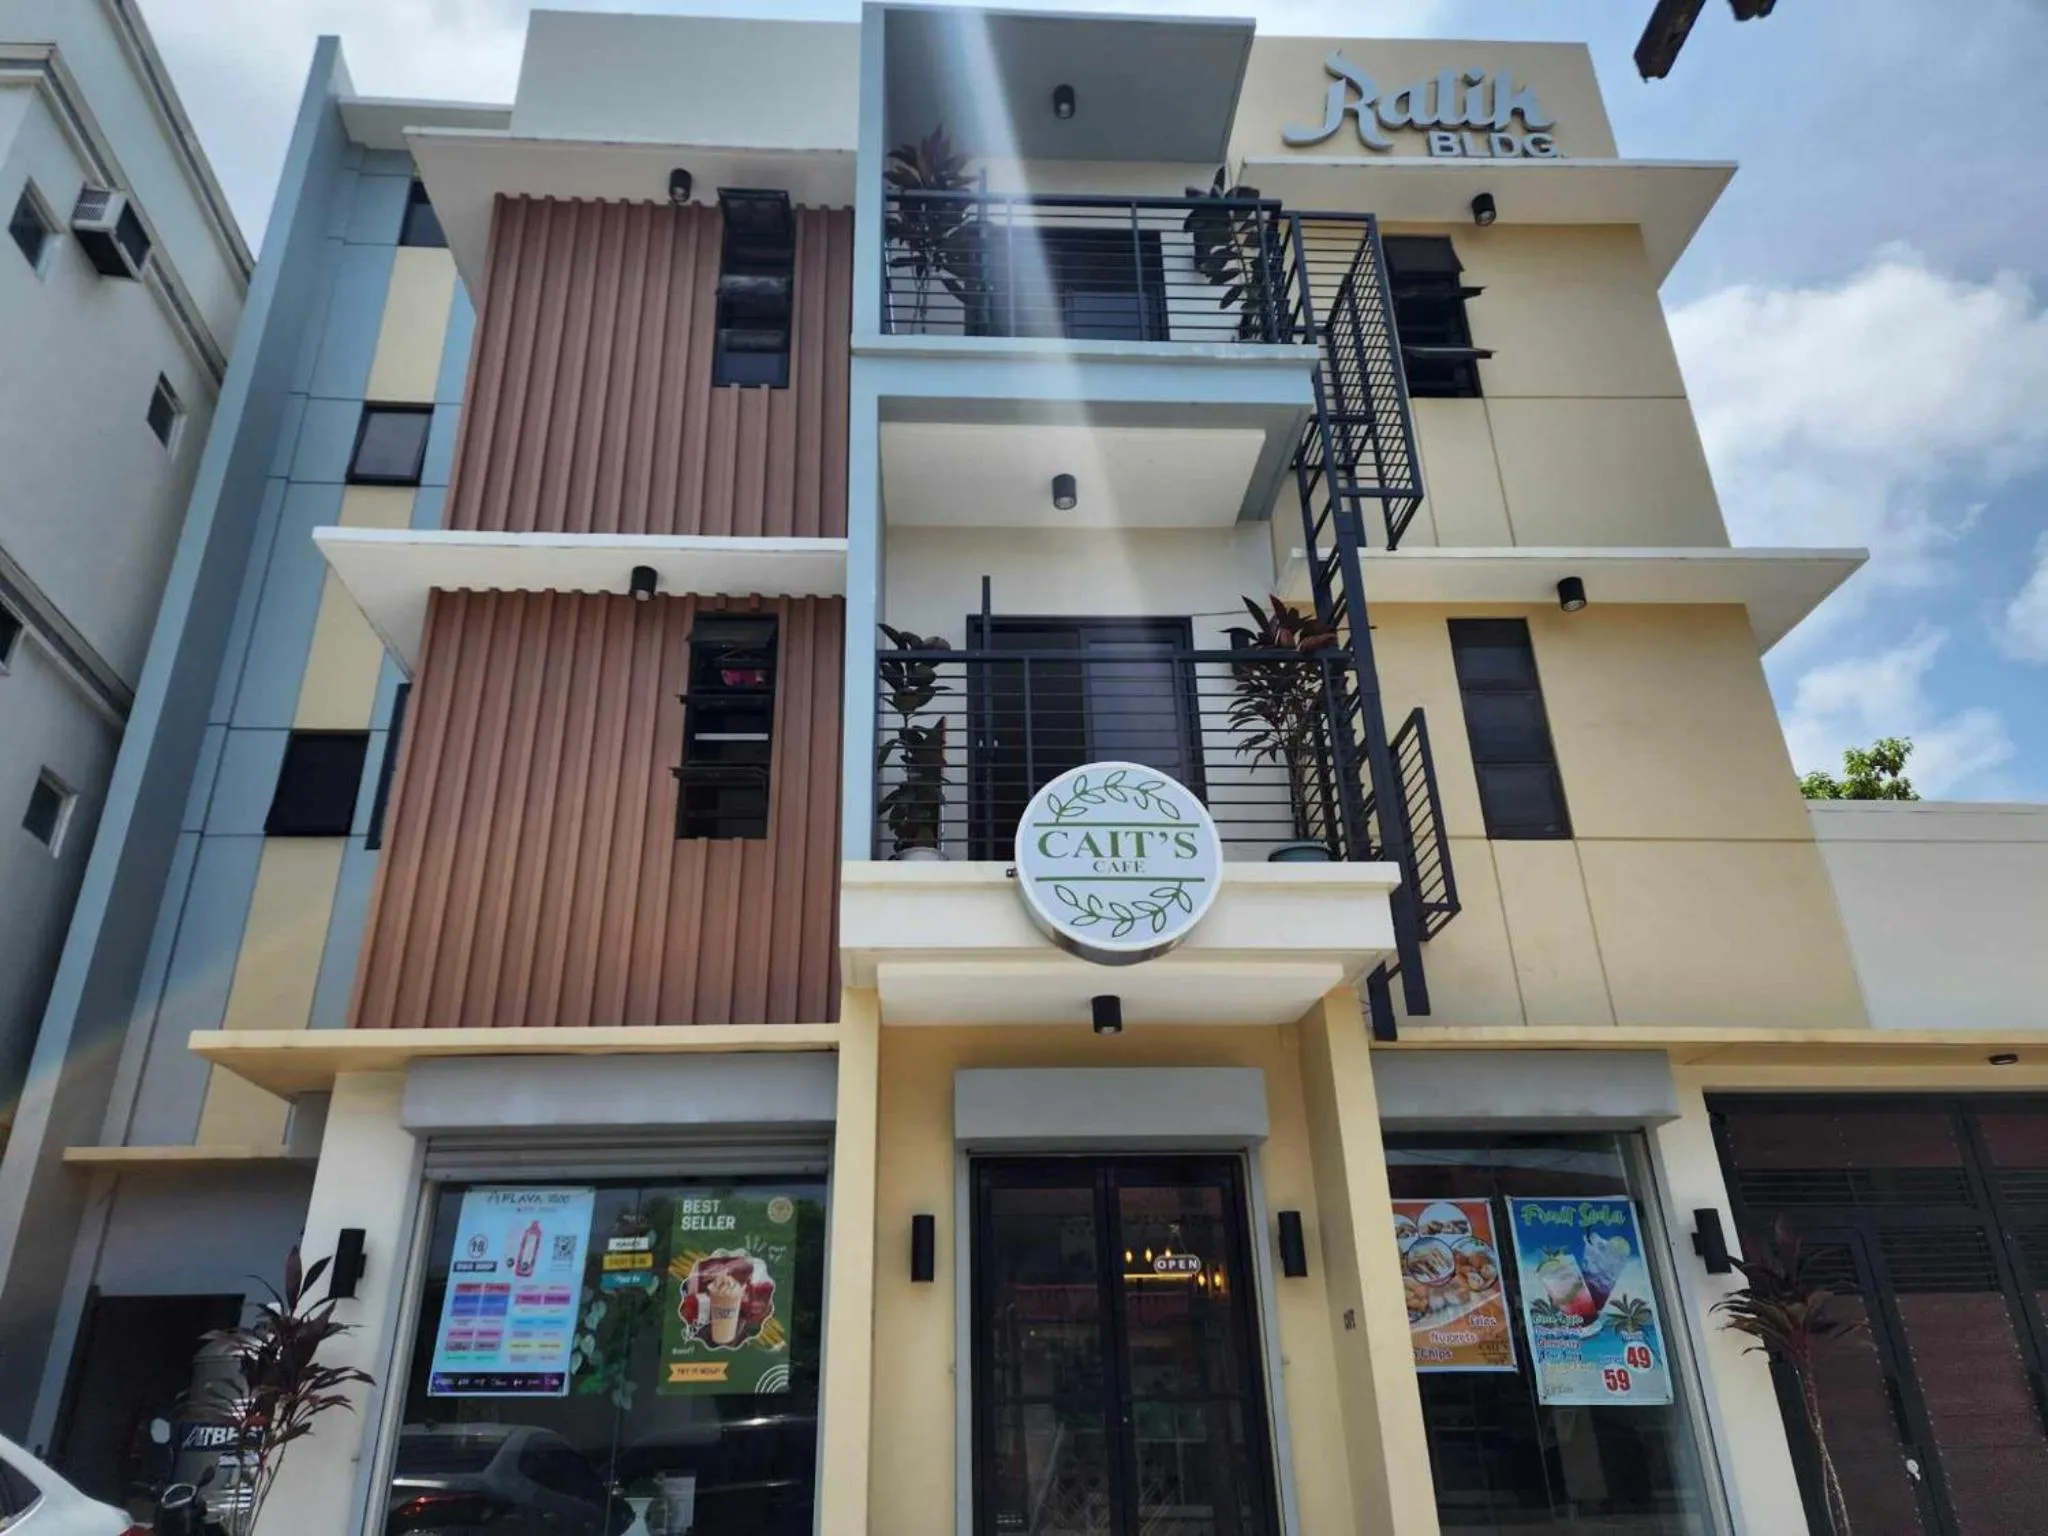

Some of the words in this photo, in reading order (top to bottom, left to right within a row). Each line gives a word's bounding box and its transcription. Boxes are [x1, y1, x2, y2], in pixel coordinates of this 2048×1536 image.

[1037, 830, 1198, 860] CAIT'S
[1092, 860, 1146, 874] CAFE
[683, 1200, 721, 1214] BEST
[1522, 1203, 1576, 1227] Fruit
[1579, 1201, 1626, 1226] Soda
[681, 1215, 736, 1231] SELLER
[1157, 1259, 1198, 1269] OPEN
[1626, 1346, 1651, 1369] 49
[1603, 1368, 1631, 1391] 59
